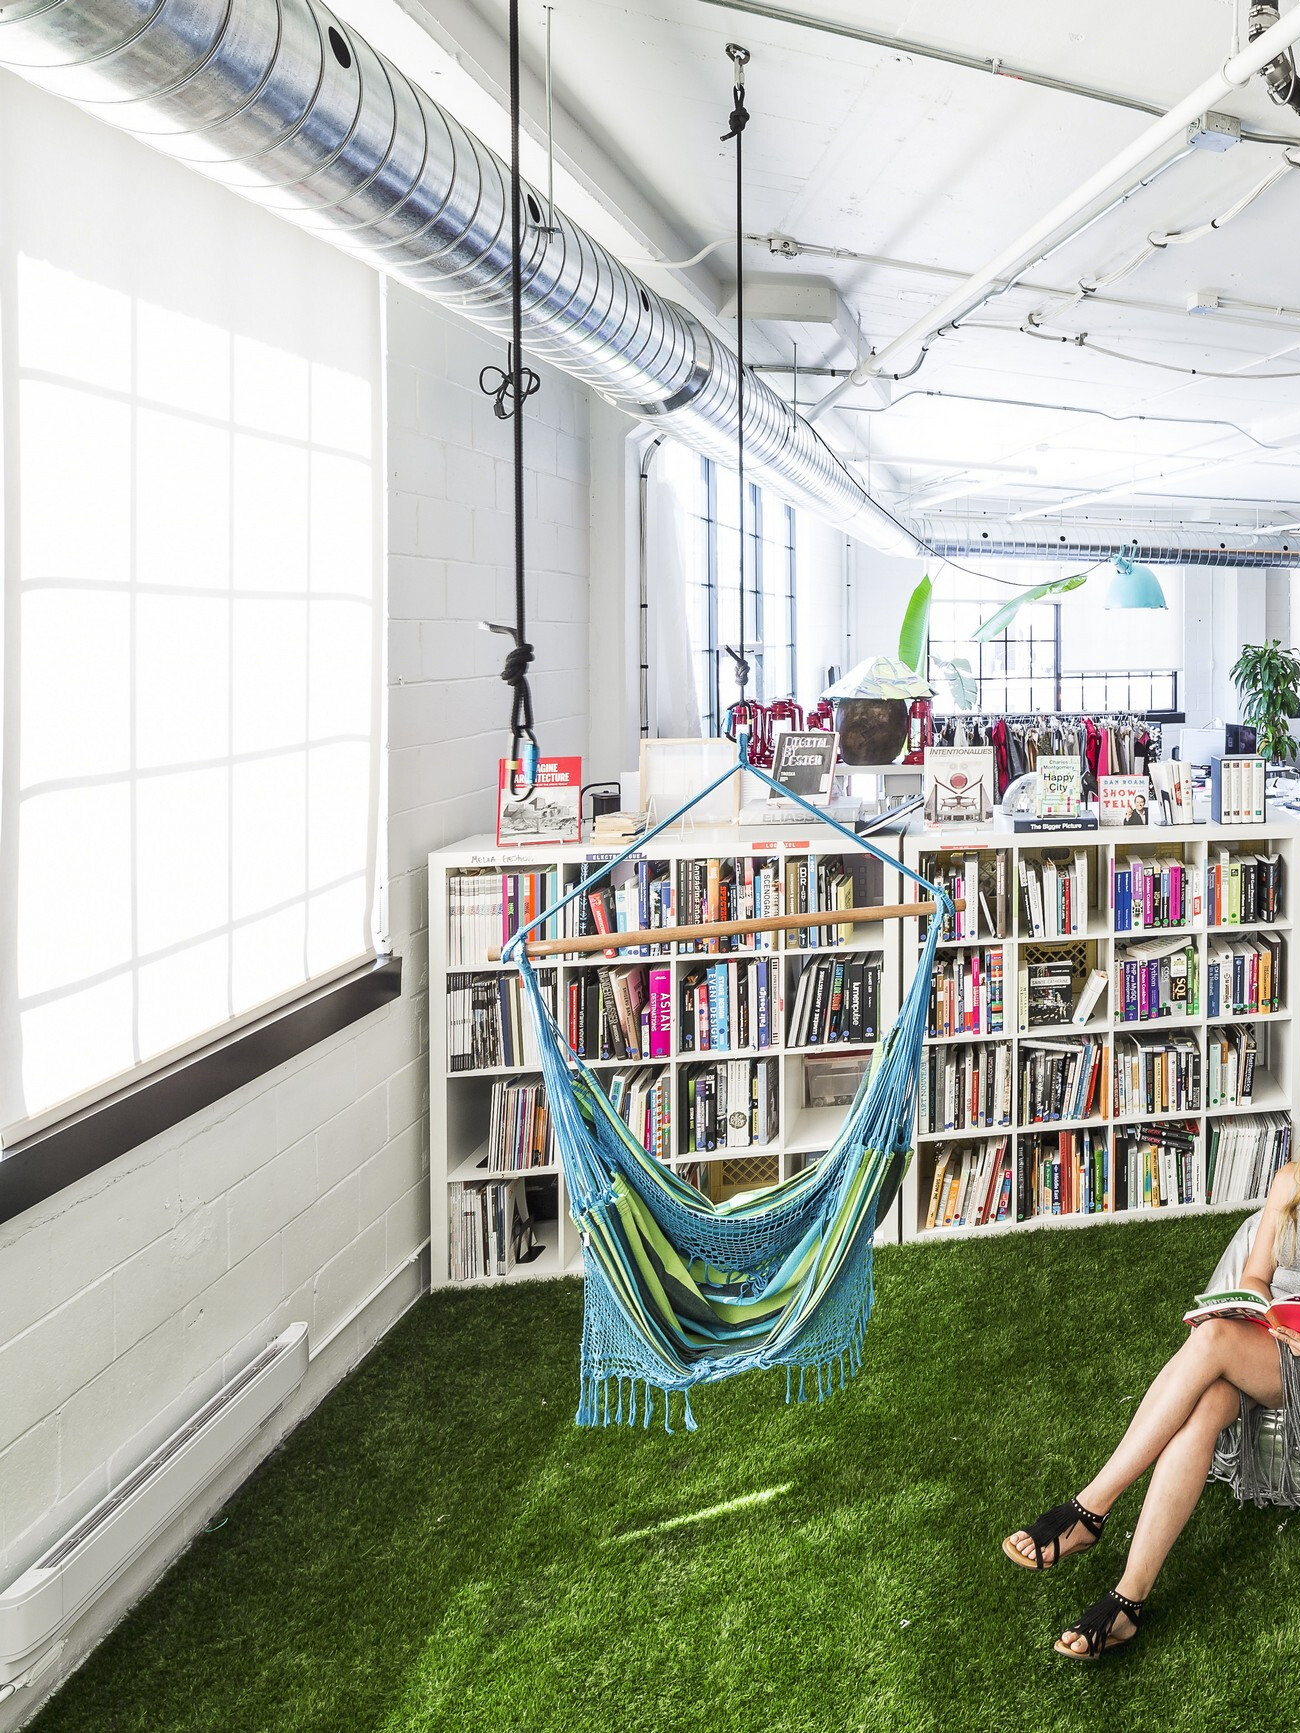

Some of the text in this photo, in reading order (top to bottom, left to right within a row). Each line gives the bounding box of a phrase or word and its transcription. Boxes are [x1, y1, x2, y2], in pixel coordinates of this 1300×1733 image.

[785, 736, 831, 749] DIGITAL
[781, 756, 823, 767] DESIGN
[514, 773, 570, 783] ARITECTURE
[1043, 773, 1074, 784] Happy
[1049, 783, 1068, 793] City
[1103, 788, 1136, 798] SHOW
[1103, 800, 1131, 809] TELL
[1030, 822, 1082, 832] The Bigger Picture
[1150, 962, 1158, 987] Python
[1176, 978, 1186, 999] SQL
[852, 982, 861, 1026] lumenpulse
[660, 993, 671, 1032] ASIAN
[1244, 1053, 1255, 1093] Mathematics
